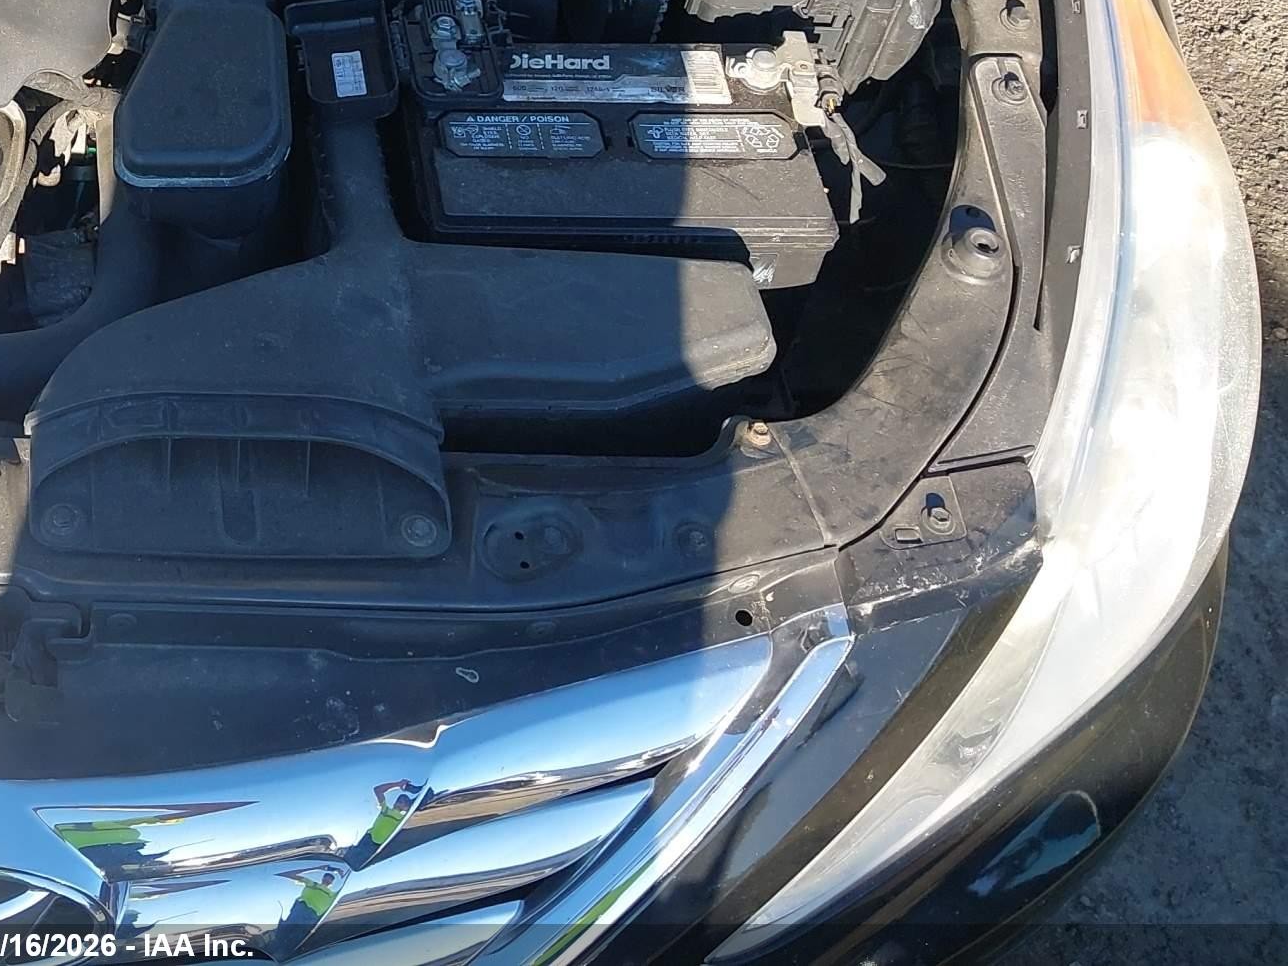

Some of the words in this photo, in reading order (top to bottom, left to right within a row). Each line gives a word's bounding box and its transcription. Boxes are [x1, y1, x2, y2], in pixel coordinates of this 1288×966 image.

[509, 53, 611, 71] DieHard
[476, 115, 519, 123] DANGER
[530, 115, 570, 123] POISON
